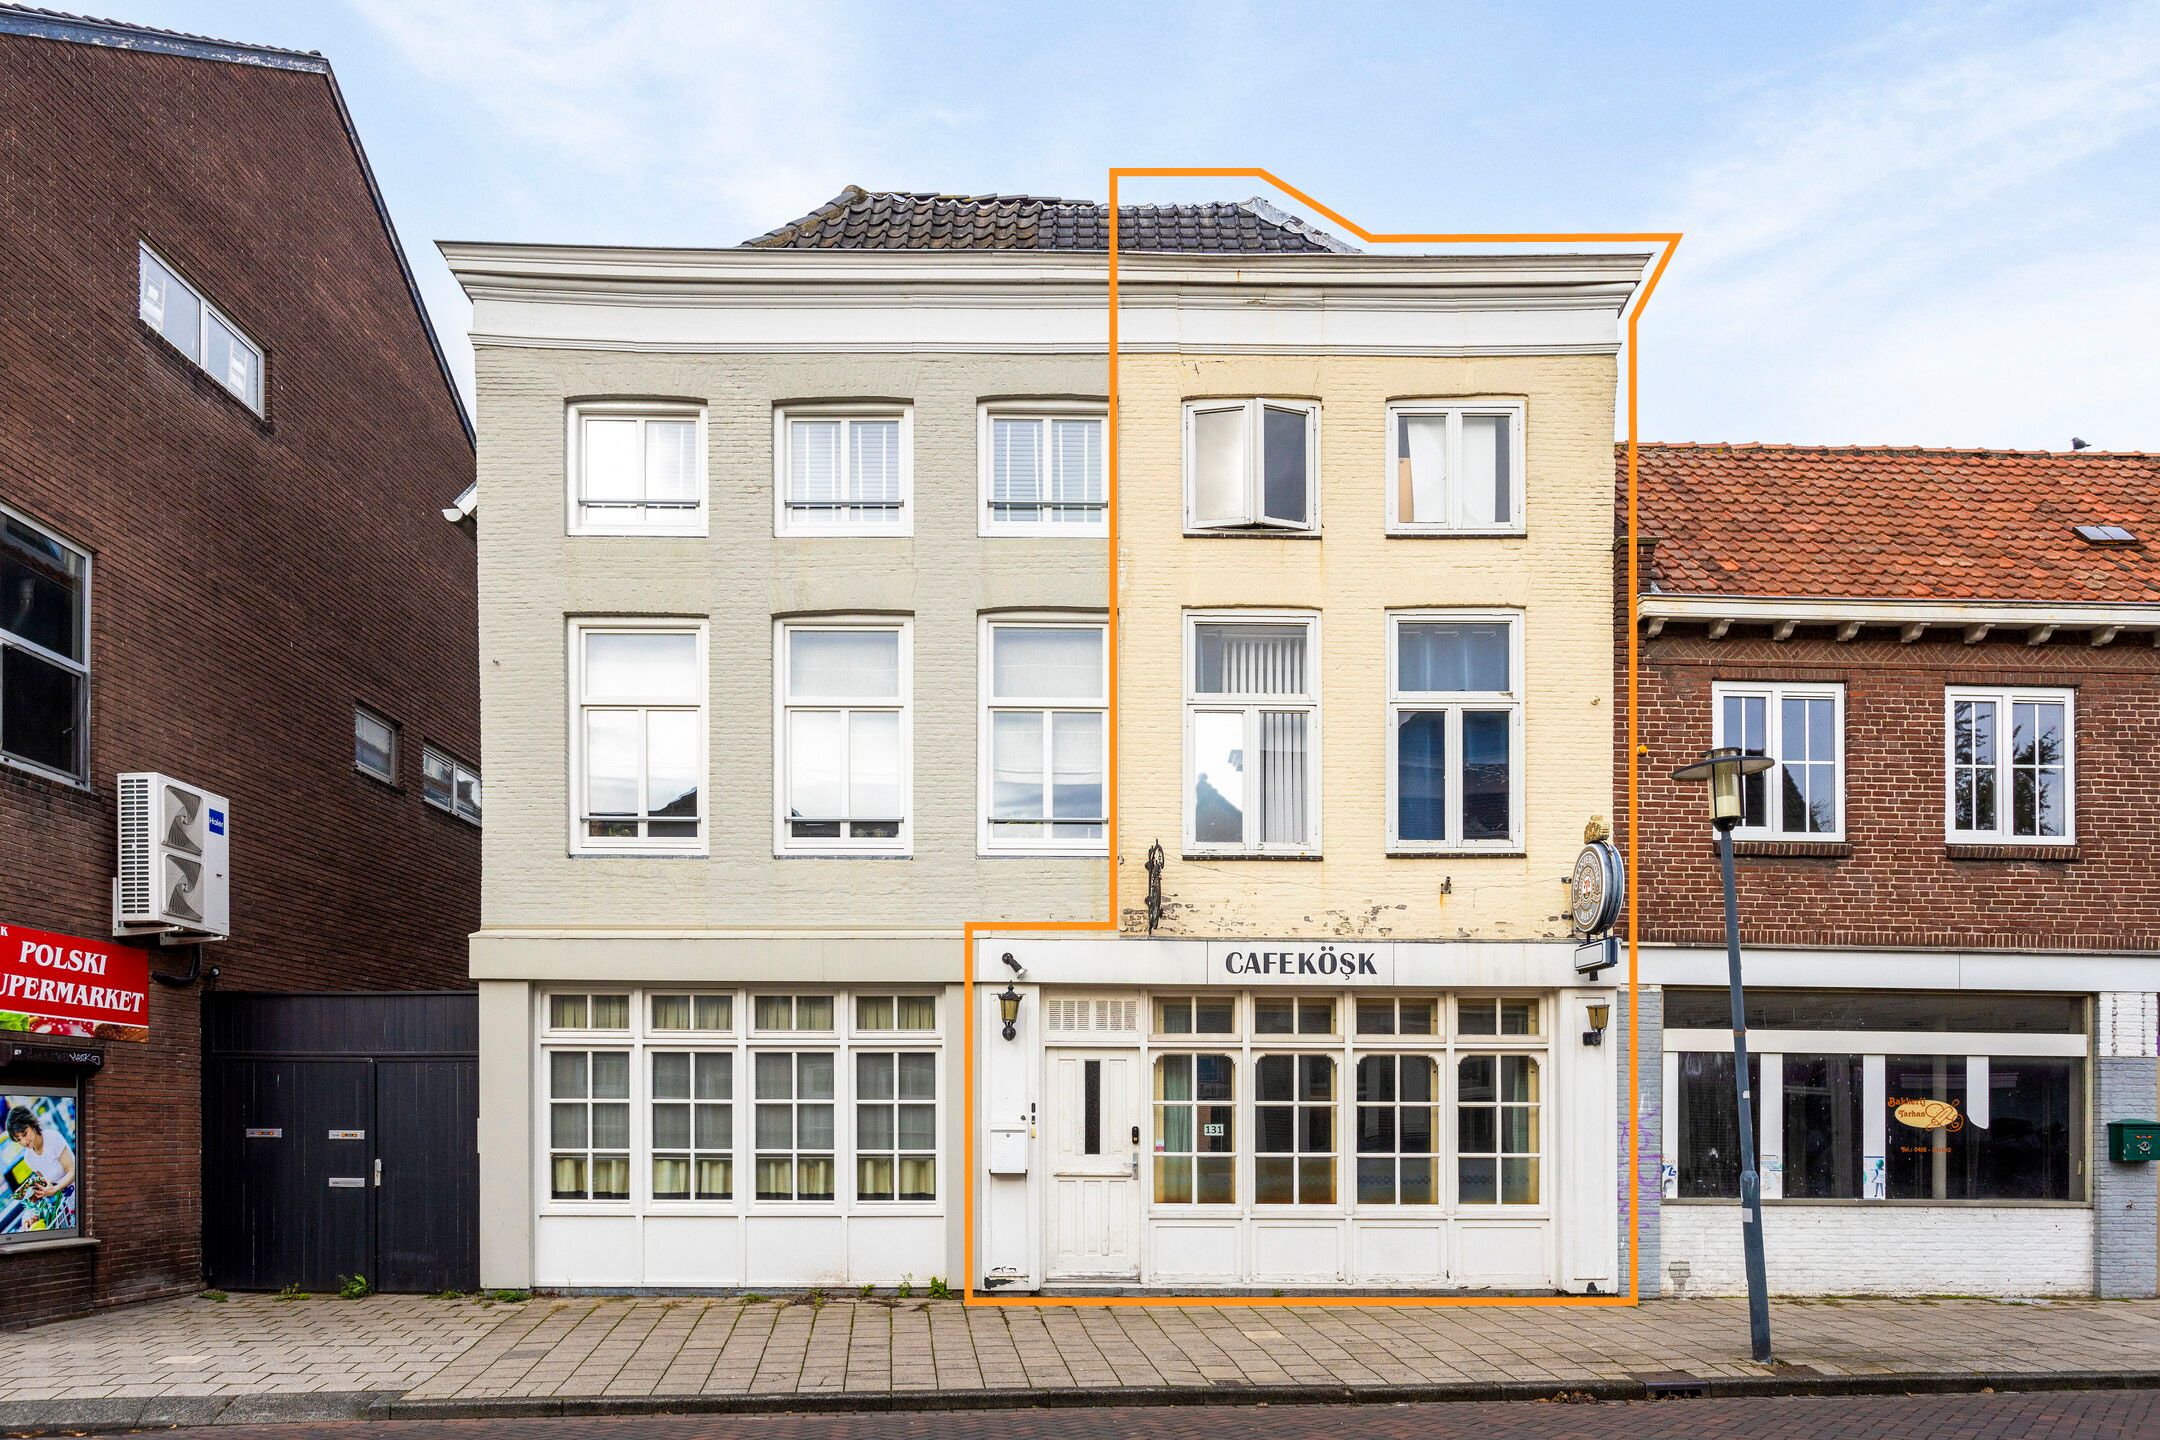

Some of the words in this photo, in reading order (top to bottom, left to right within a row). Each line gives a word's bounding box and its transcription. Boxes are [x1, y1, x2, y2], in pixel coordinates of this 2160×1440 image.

[209, 817, 224, 828] Haier
[1580, 910, 1594, 921] BIER
[19, 940, 108, 975] POLSKI
[1887, 1096, 1926, 1107] Bakkerij
[1205, 1126, 1222, 1134] 131
